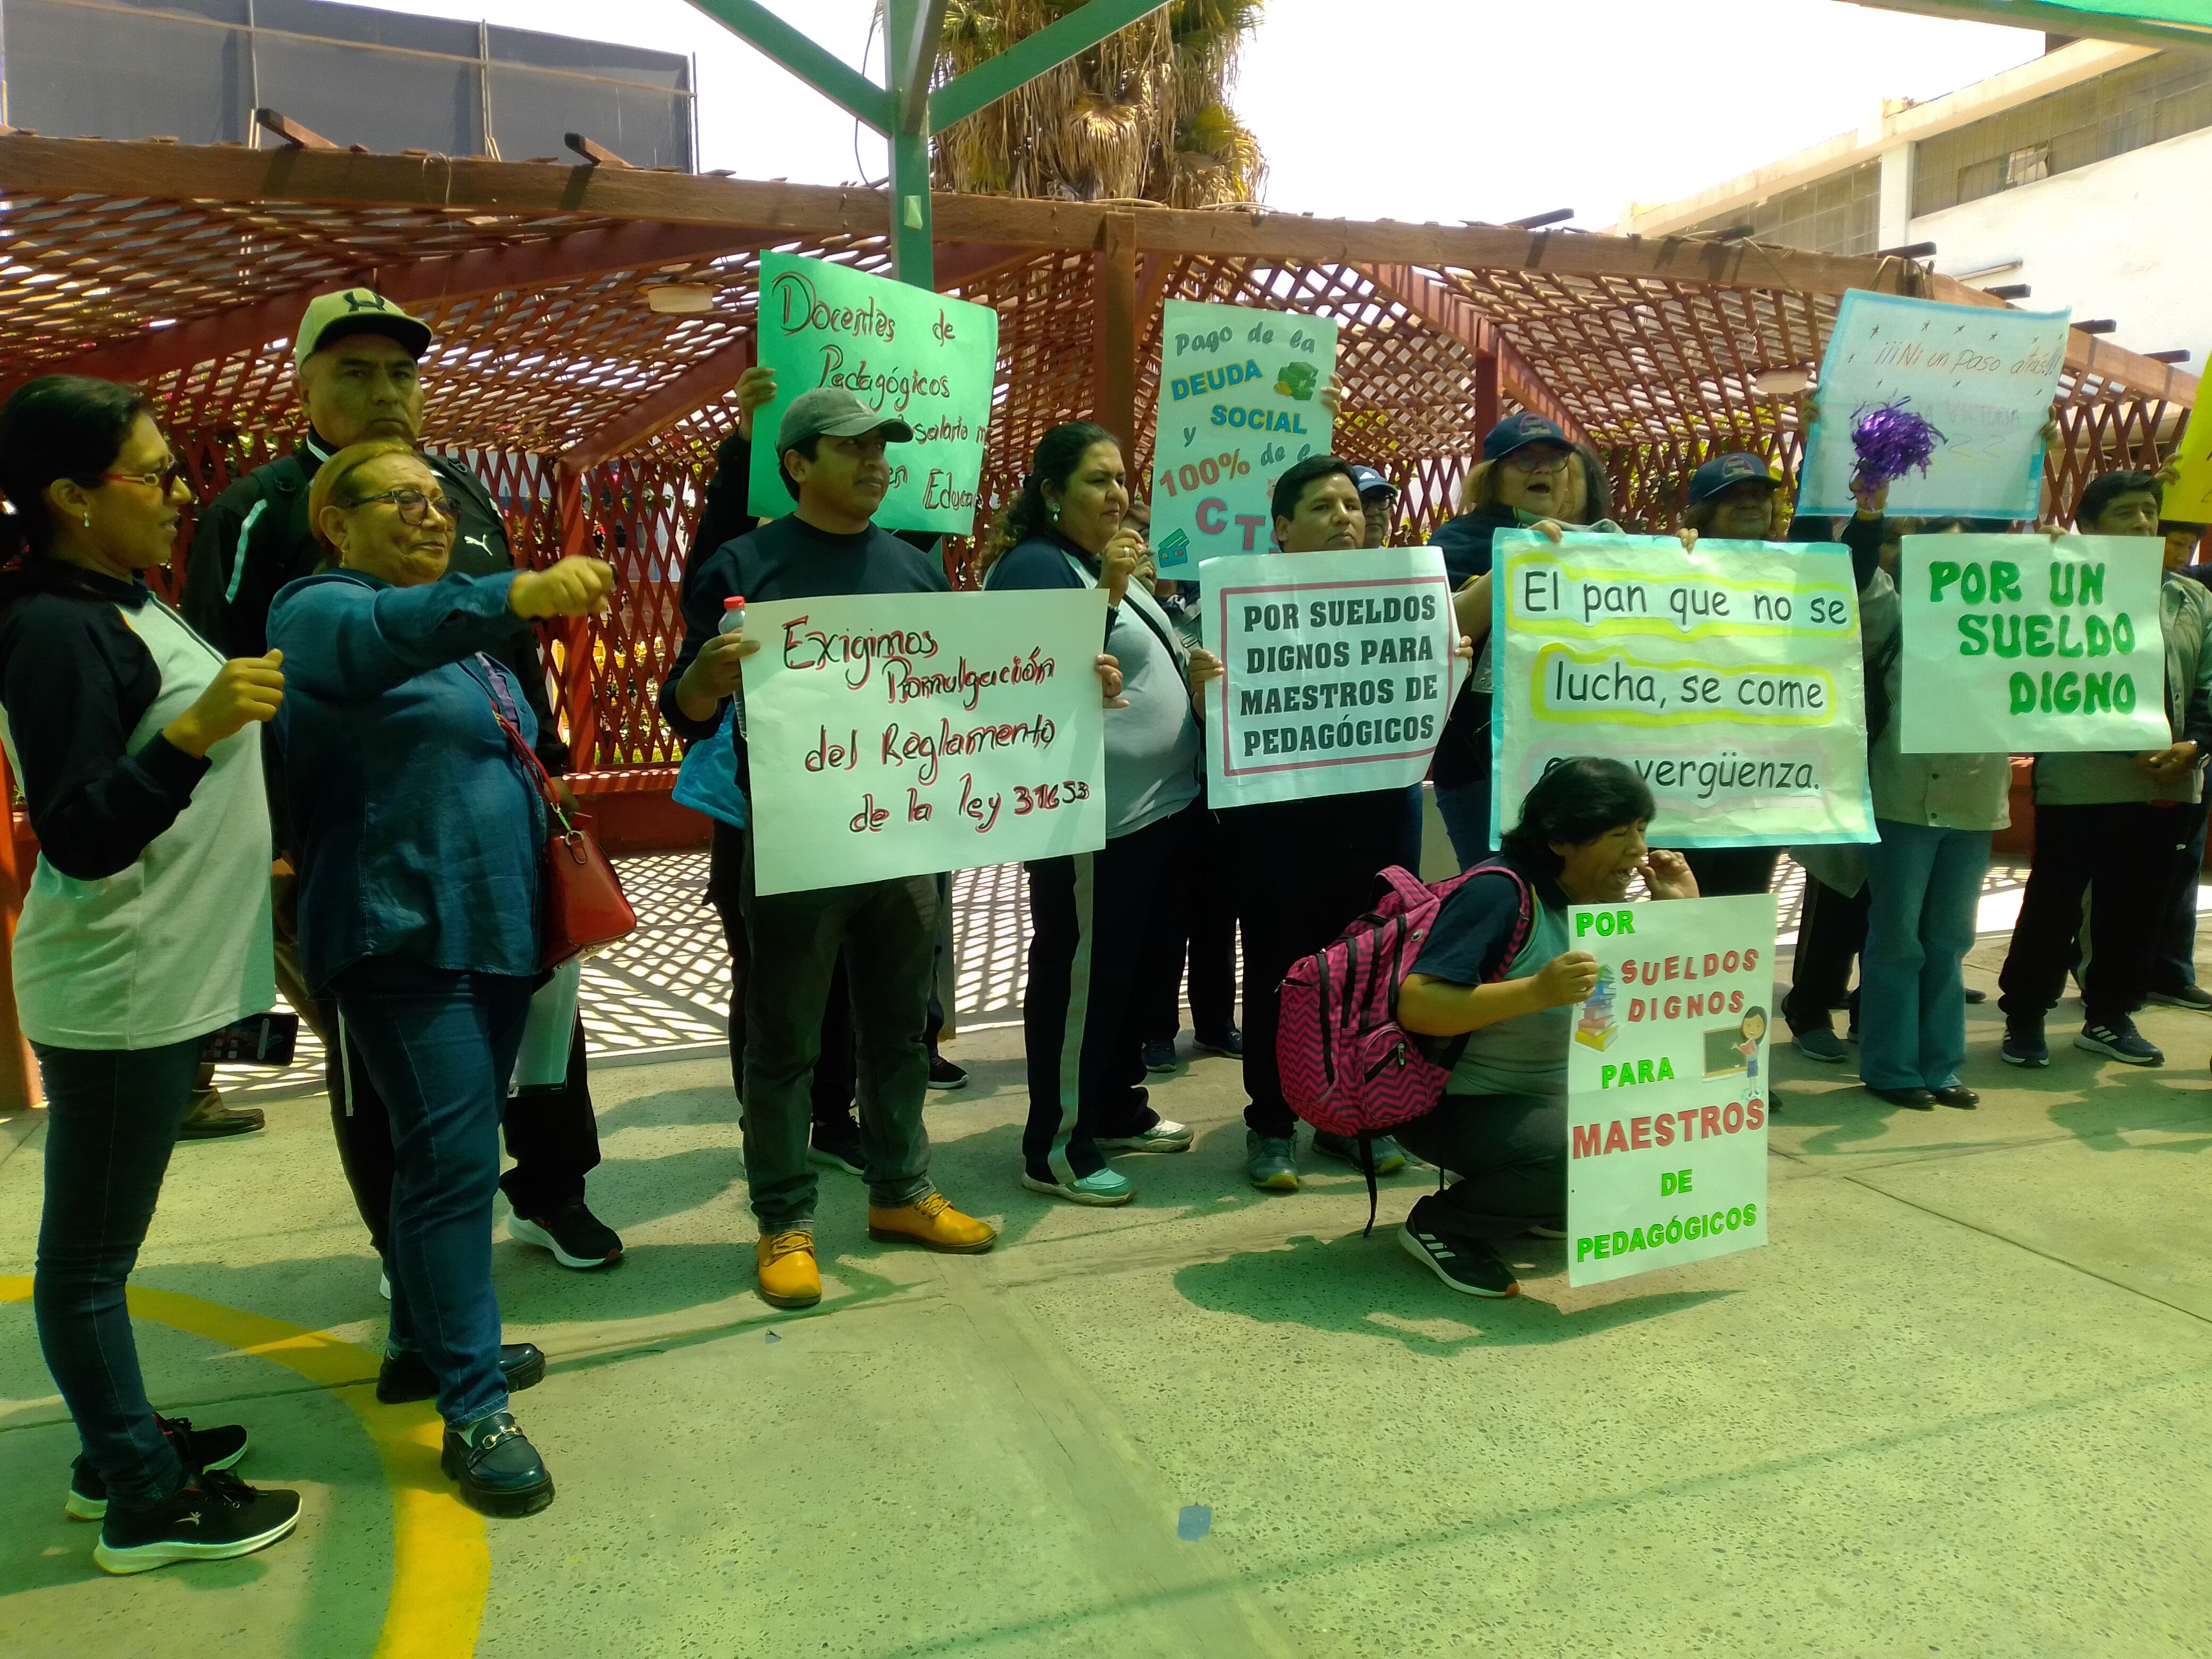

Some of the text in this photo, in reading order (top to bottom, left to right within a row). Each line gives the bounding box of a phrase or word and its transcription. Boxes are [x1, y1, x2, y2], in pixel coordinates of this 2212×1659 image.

[771, 270, 956, 347] Docentes de
[1175, 321, 1316, 356] Pago de la
[1927, 351, 1948, 368] un
[815, 343, 950, 412] Pedagógicos
[1171, 359, 1263, 401] DEUDA
[1184, 426, 1196, 447] y
[1211, 405, 1308, 434] SOCIAL
[1159, 449, 1250, 497] 100%
[1260, 442, 1285, 466] de
[1524, 570, 1848, 624] El pan que no se
[1929, 560, 2105, 607] POR UN
[1244, 594, 1436, 632] POR SUELDOS
[782, 615, 938, 690] Exigimos
[1246, 635, 1434, 674] DIGNOS PARA
[1958, 613, 2135, 658] SUELDO
[1240, 674, 1438, 716] MAESTROS DE
[1556, 660, 1824, 709] lucha, se come
[2009, 671, 2136, 715] DIGNO
[805, 715, 1055, 786] del Reglamento
[1244, 714, 1435, 757] PEDAGÓGICOS
[1635, 751, 1821, 799] vergüenza.
[849, 773, 1090, 833] de la ley 31653
[1576, 910, 1635, 937] POR
[1621, 949, 1759, 985] SUELDOS
[1628, 990, 1745, 1022] DIGNOS
[1602, 1057, 1674, 1088] PARA
[1572, 1099, 1764, 1159] MAESTROS
[1661, 1168, 1692, 1196] DE
[1577, 1203, 1756, 1262] PEDAGÓGICOS
